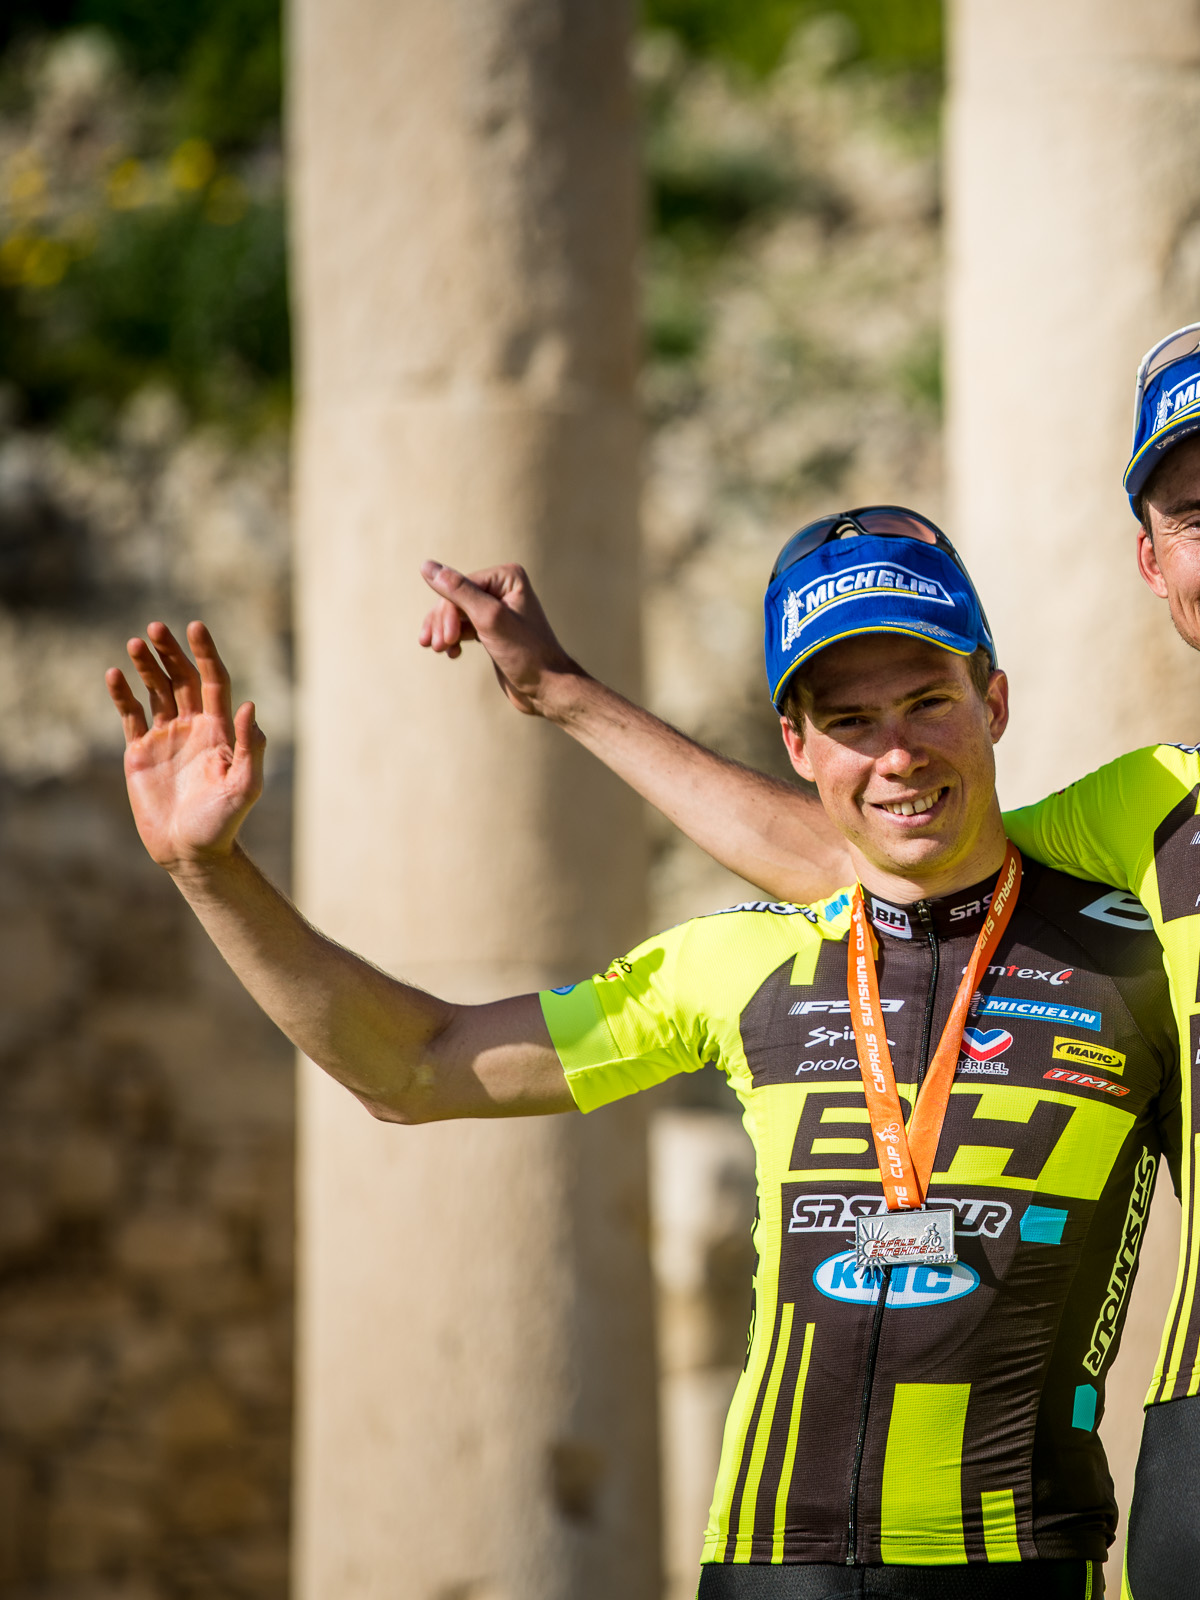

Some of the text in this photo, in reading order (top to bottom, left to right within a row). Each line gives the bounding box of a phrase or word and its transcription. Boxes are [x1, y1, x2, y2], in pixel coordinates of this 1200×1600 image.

[806, 569, 937, 613] MICHELIN
[875, 906, 906, 927] BH
[856, 923, 886, 1093] CYPRUS SUNSHINE CUP
[986, 1000, 1096, 1024] MICHELIN
[1066, 1045, 1114, 1064] MAVIC
[1051, 1069, 1127, 1095] TIME
[887, 1146, 904, 1178] CUP
